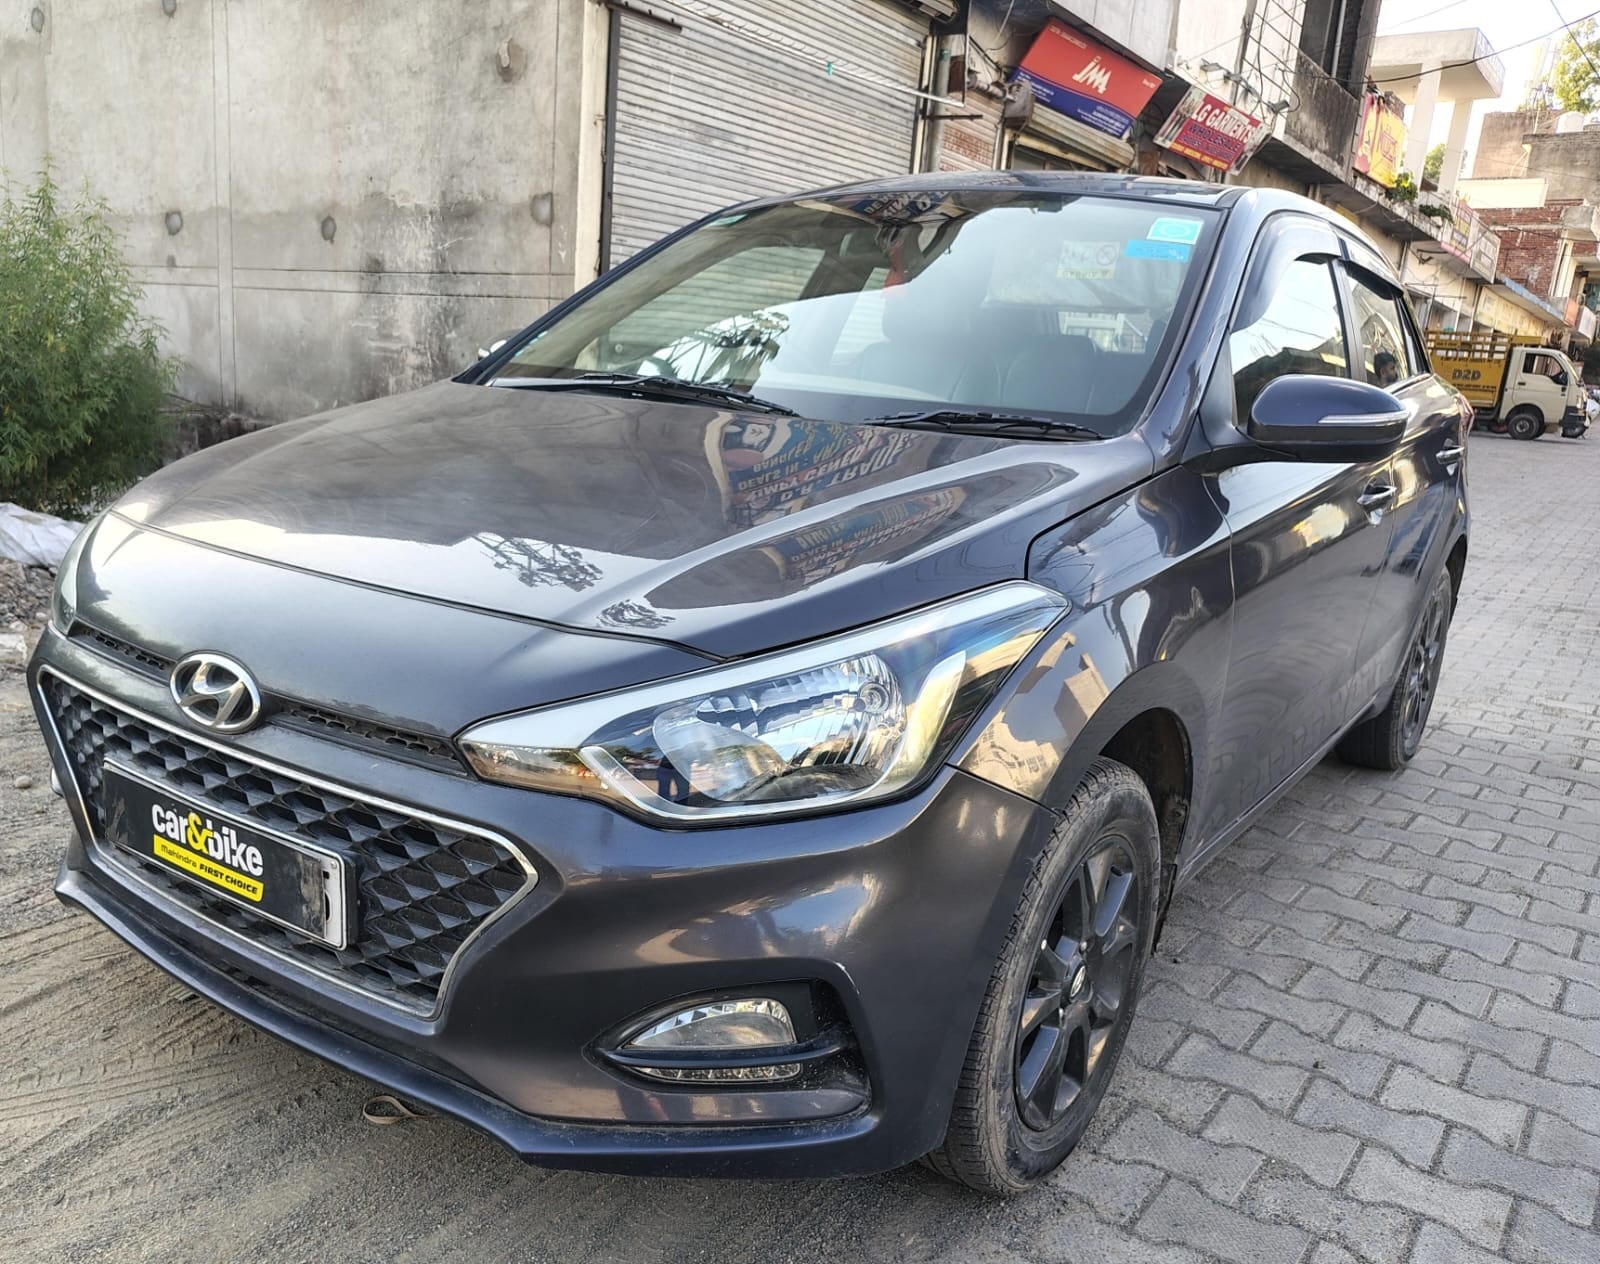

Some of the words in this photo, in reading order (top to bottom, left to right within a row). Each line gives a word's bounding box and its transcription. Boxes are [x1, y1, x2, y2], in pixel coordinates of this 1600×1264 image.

[1452, 368, 1481, 380] D2D
[152, 804, 264, 877] car&bike
[199, 863, 224, 879] FIRST
[225, 874, 259, 895] CHOICE
